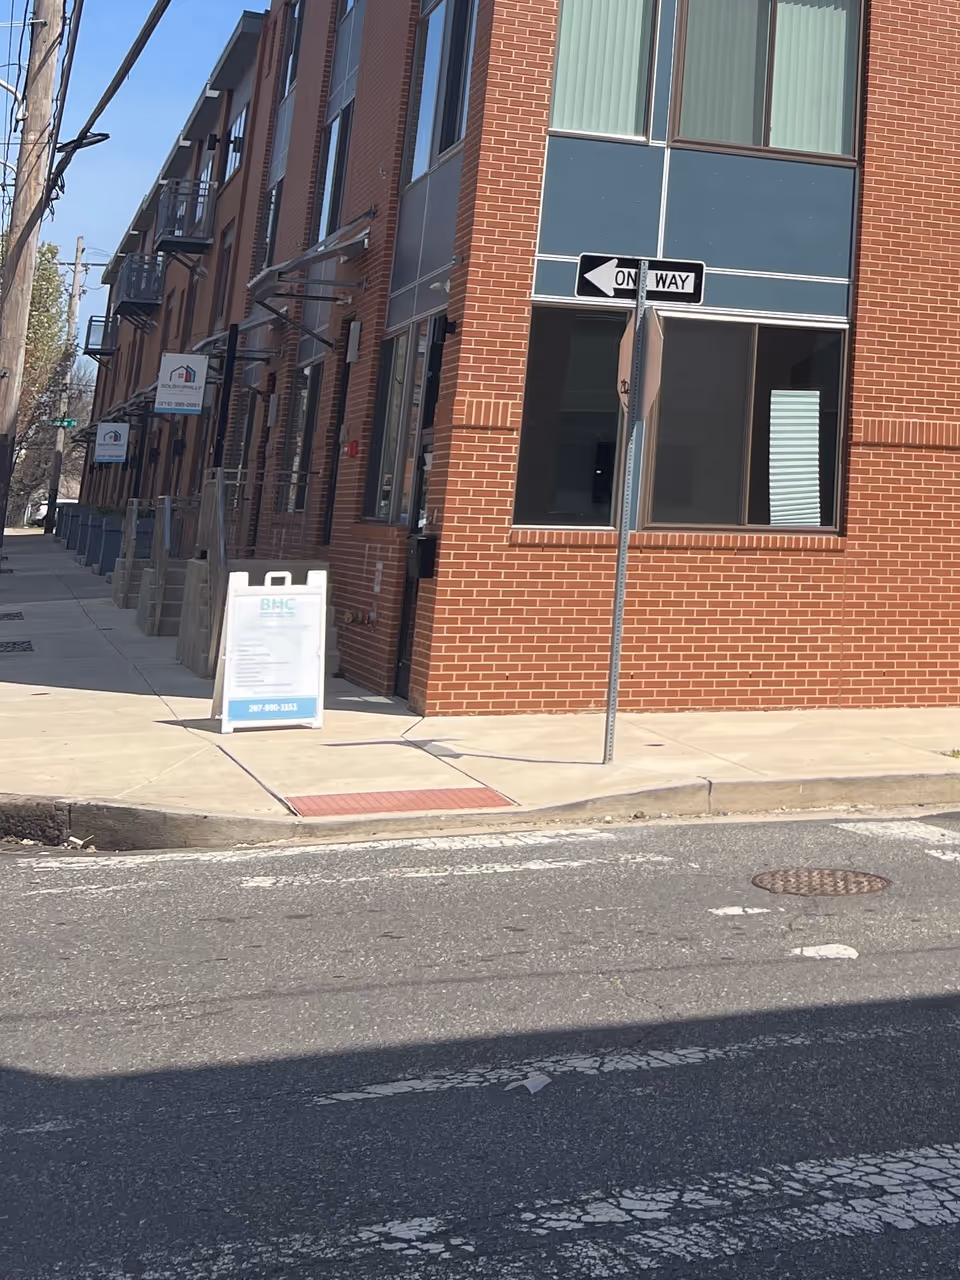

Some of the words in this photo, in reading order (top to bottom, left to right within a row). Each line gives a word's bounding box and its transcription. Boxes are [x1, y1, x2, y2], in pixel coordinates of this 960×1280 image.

[614, 270, 639, 287] ON
[655, 272, 691, 291] WAY
[260, 597, 298, 611] BHC
